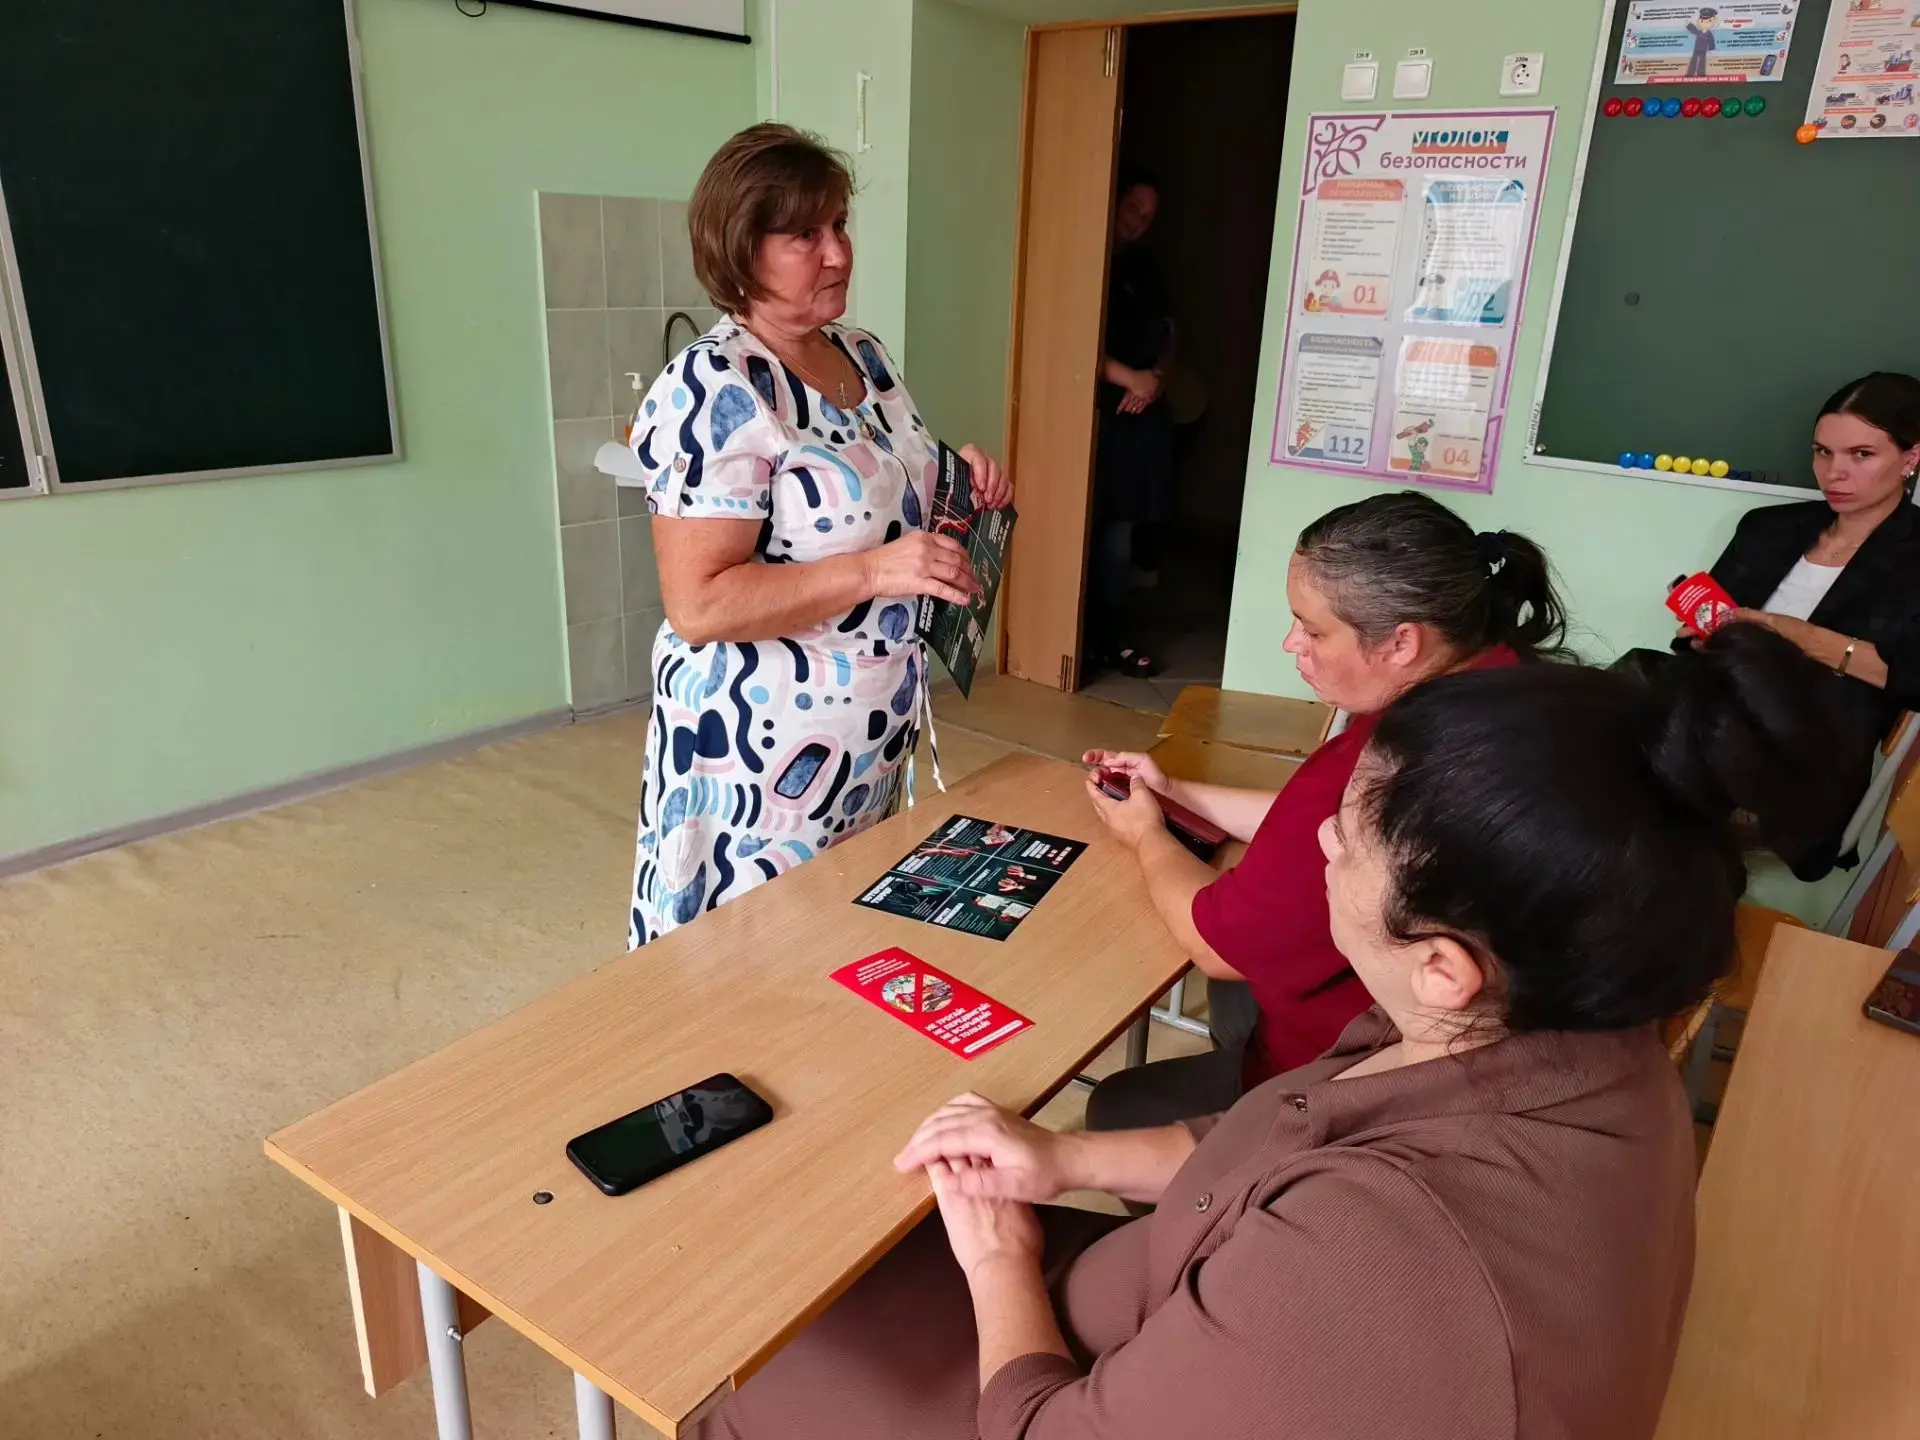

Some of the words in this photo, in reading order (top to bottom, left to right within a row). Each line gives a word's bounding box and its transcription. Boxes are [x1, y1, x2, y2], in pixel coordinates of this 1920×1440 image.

[1413, 131, 1502, 148] УГОЛОК
[1380, 152, 1528, 169] безопасности
[1353, 284, 1377, 305] 01
[1329, 435, 1365, 456] 112
[1443, 447, 1470, 466] 04
